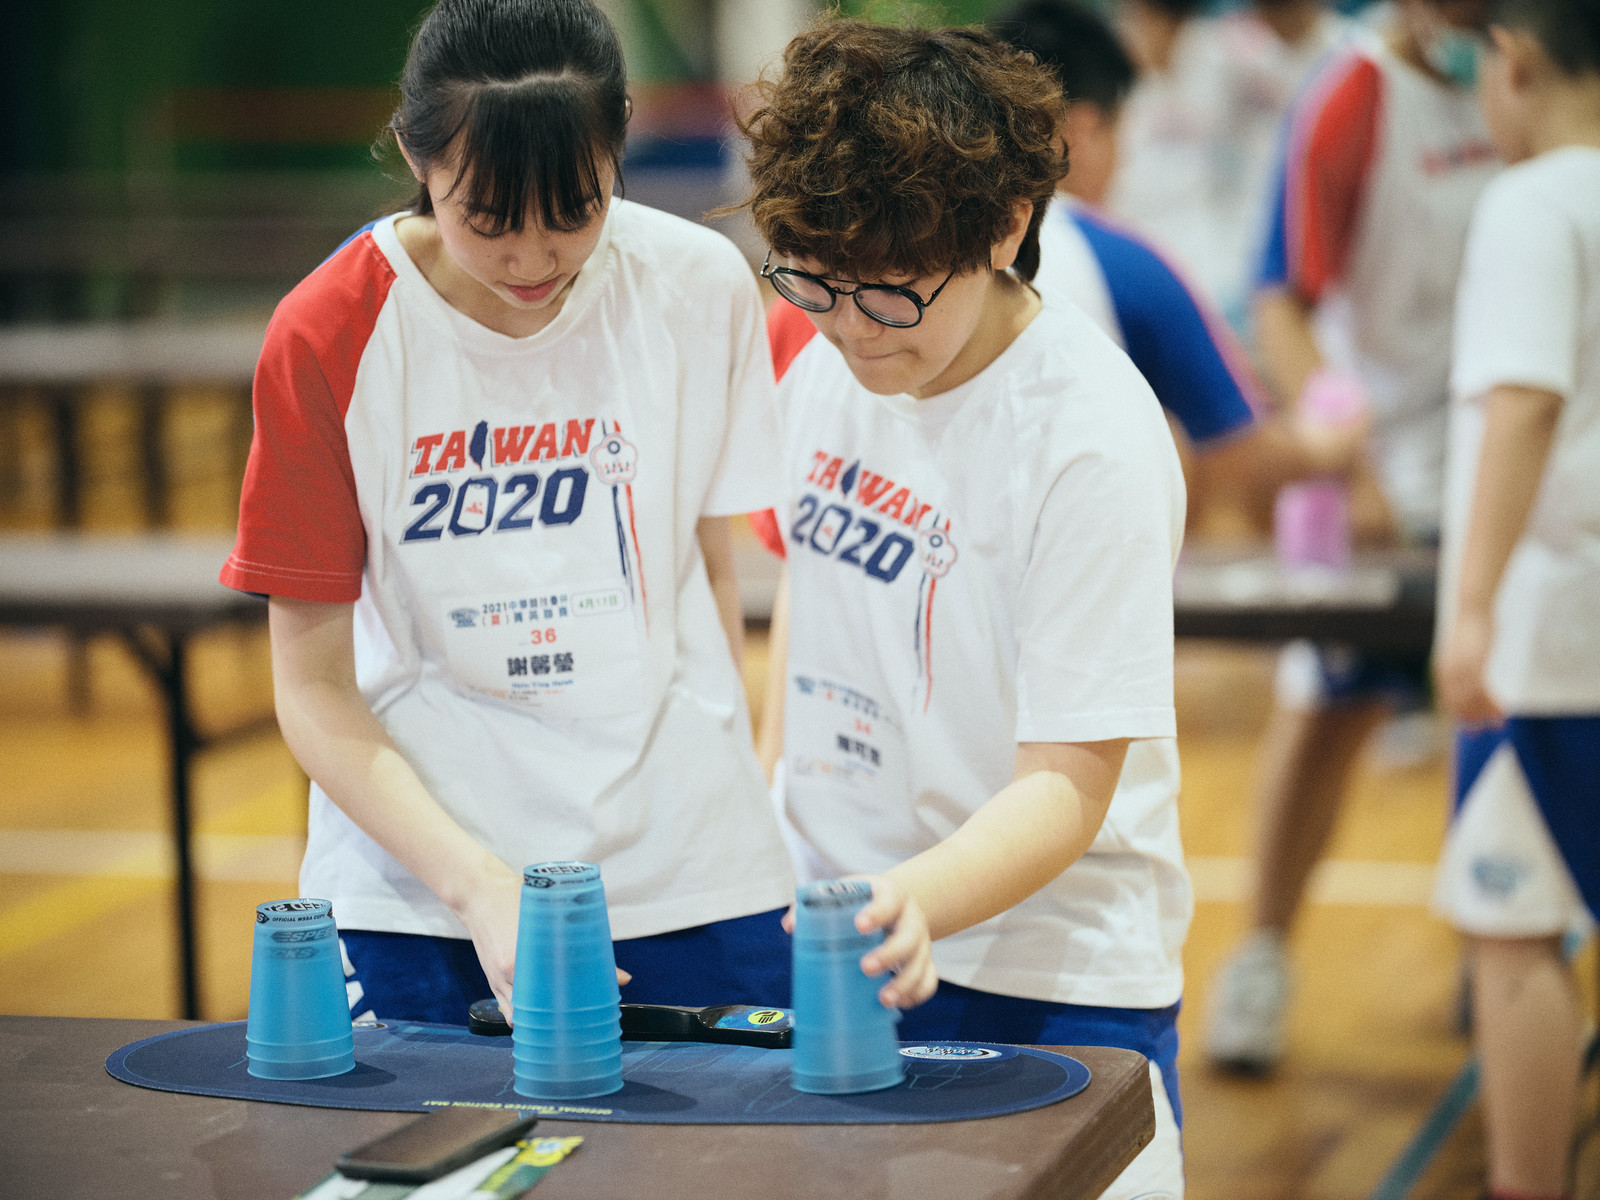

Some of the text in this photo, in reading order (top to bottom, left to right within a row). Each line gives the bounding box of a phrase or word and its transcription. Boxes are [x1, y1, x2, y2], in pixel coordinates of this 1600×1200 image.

[410, 418, 596, 478] TAIWAN
[399, 465, 590, 545] 2020
[806, 449, 933, 531] TAIWAN
[791, 493, 916, 584] 2020
[530, 628, 557, 645] 36
